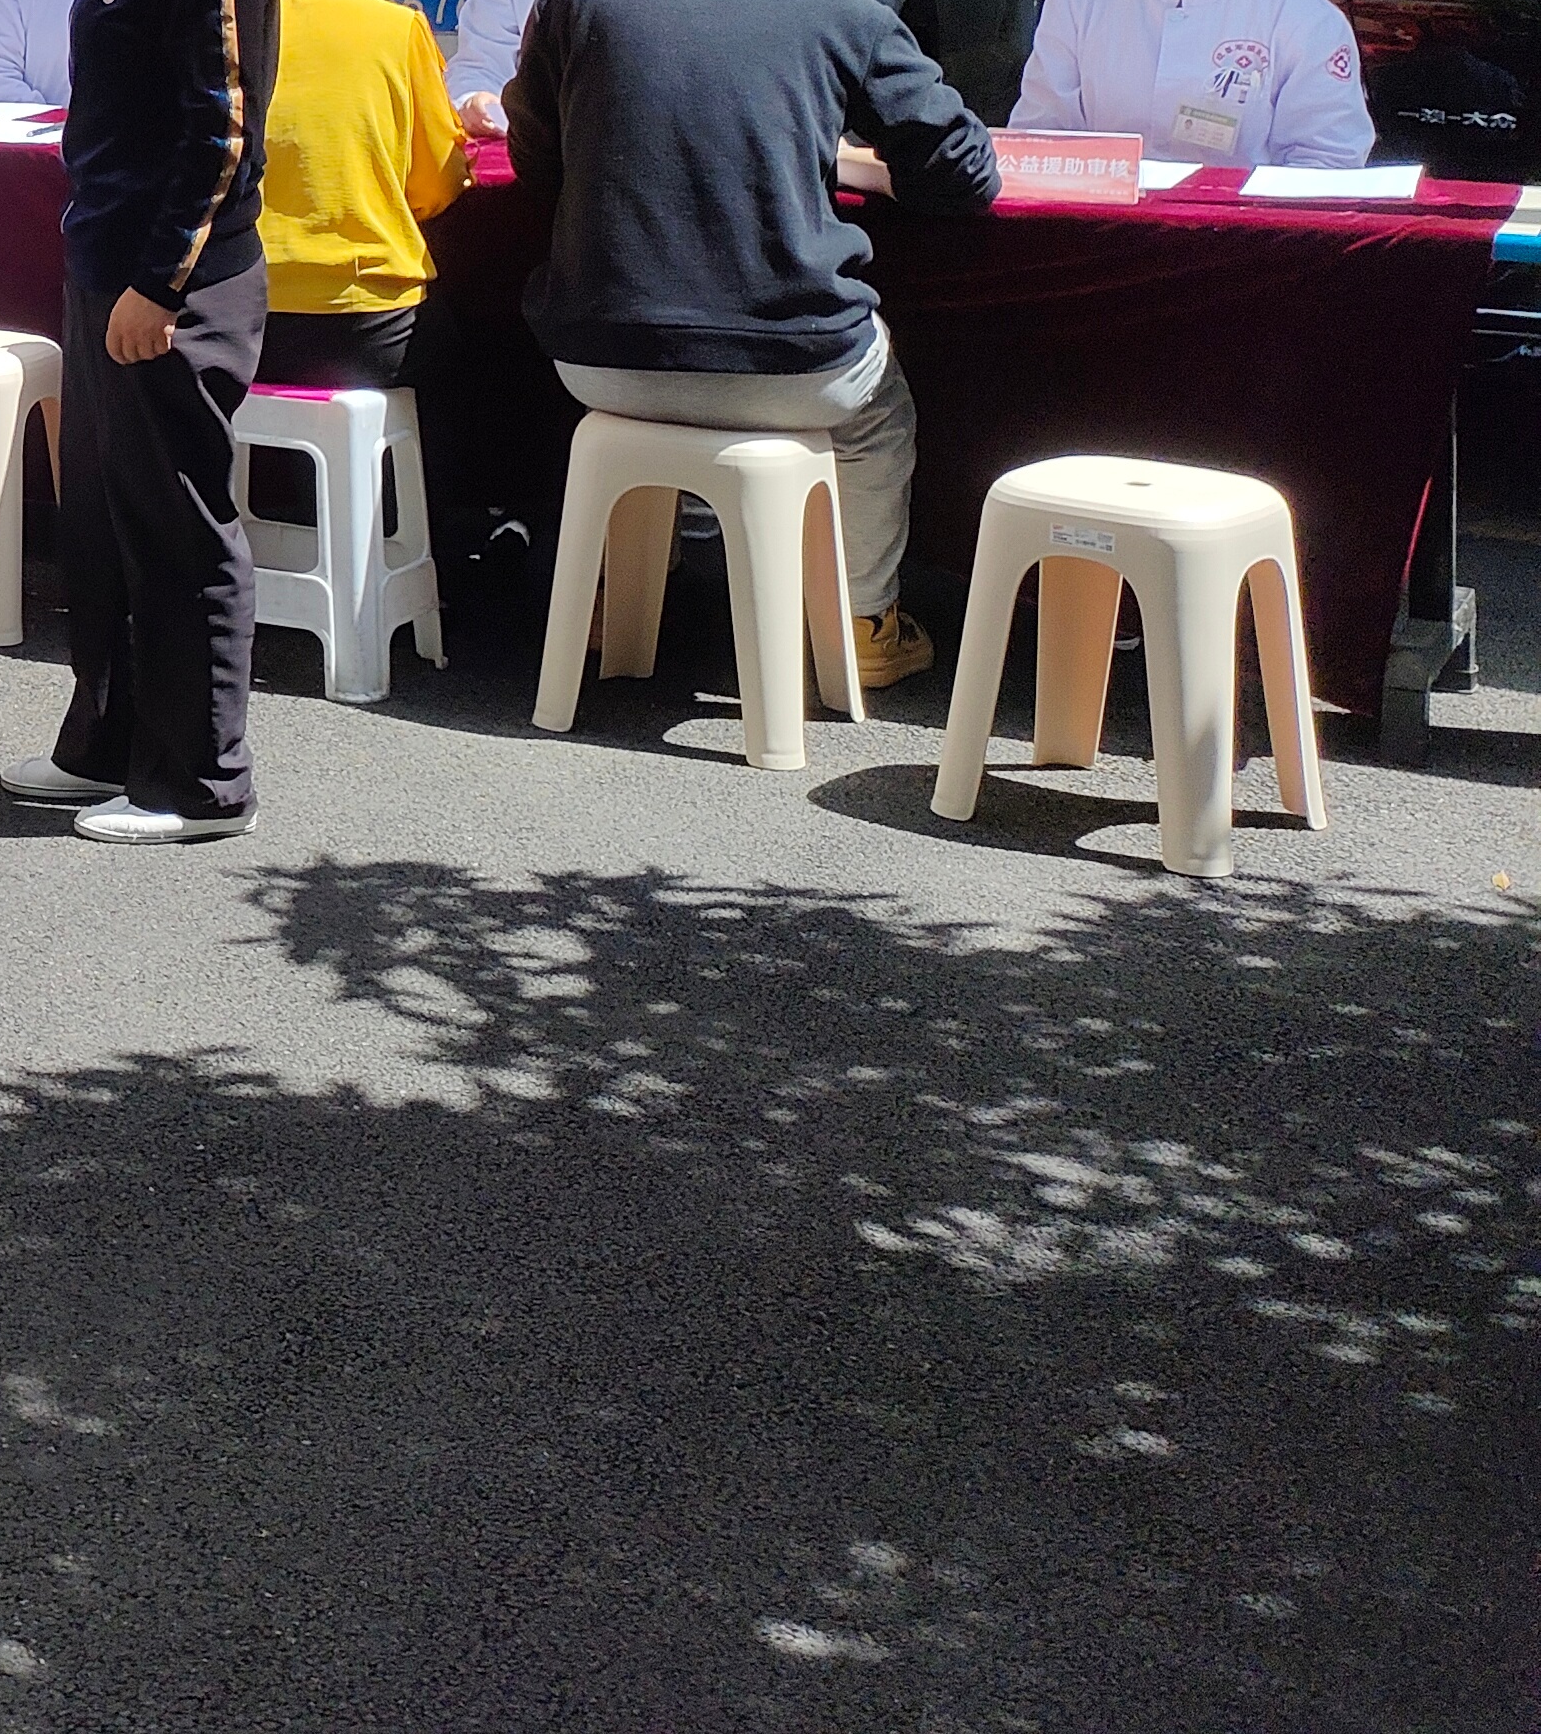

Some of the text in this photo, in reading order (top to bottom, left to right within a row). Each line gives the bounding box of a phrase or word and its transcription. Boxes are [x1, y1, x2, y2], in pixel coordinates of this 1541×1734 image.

[996, 154, 1130, 179] 公益援助审核
